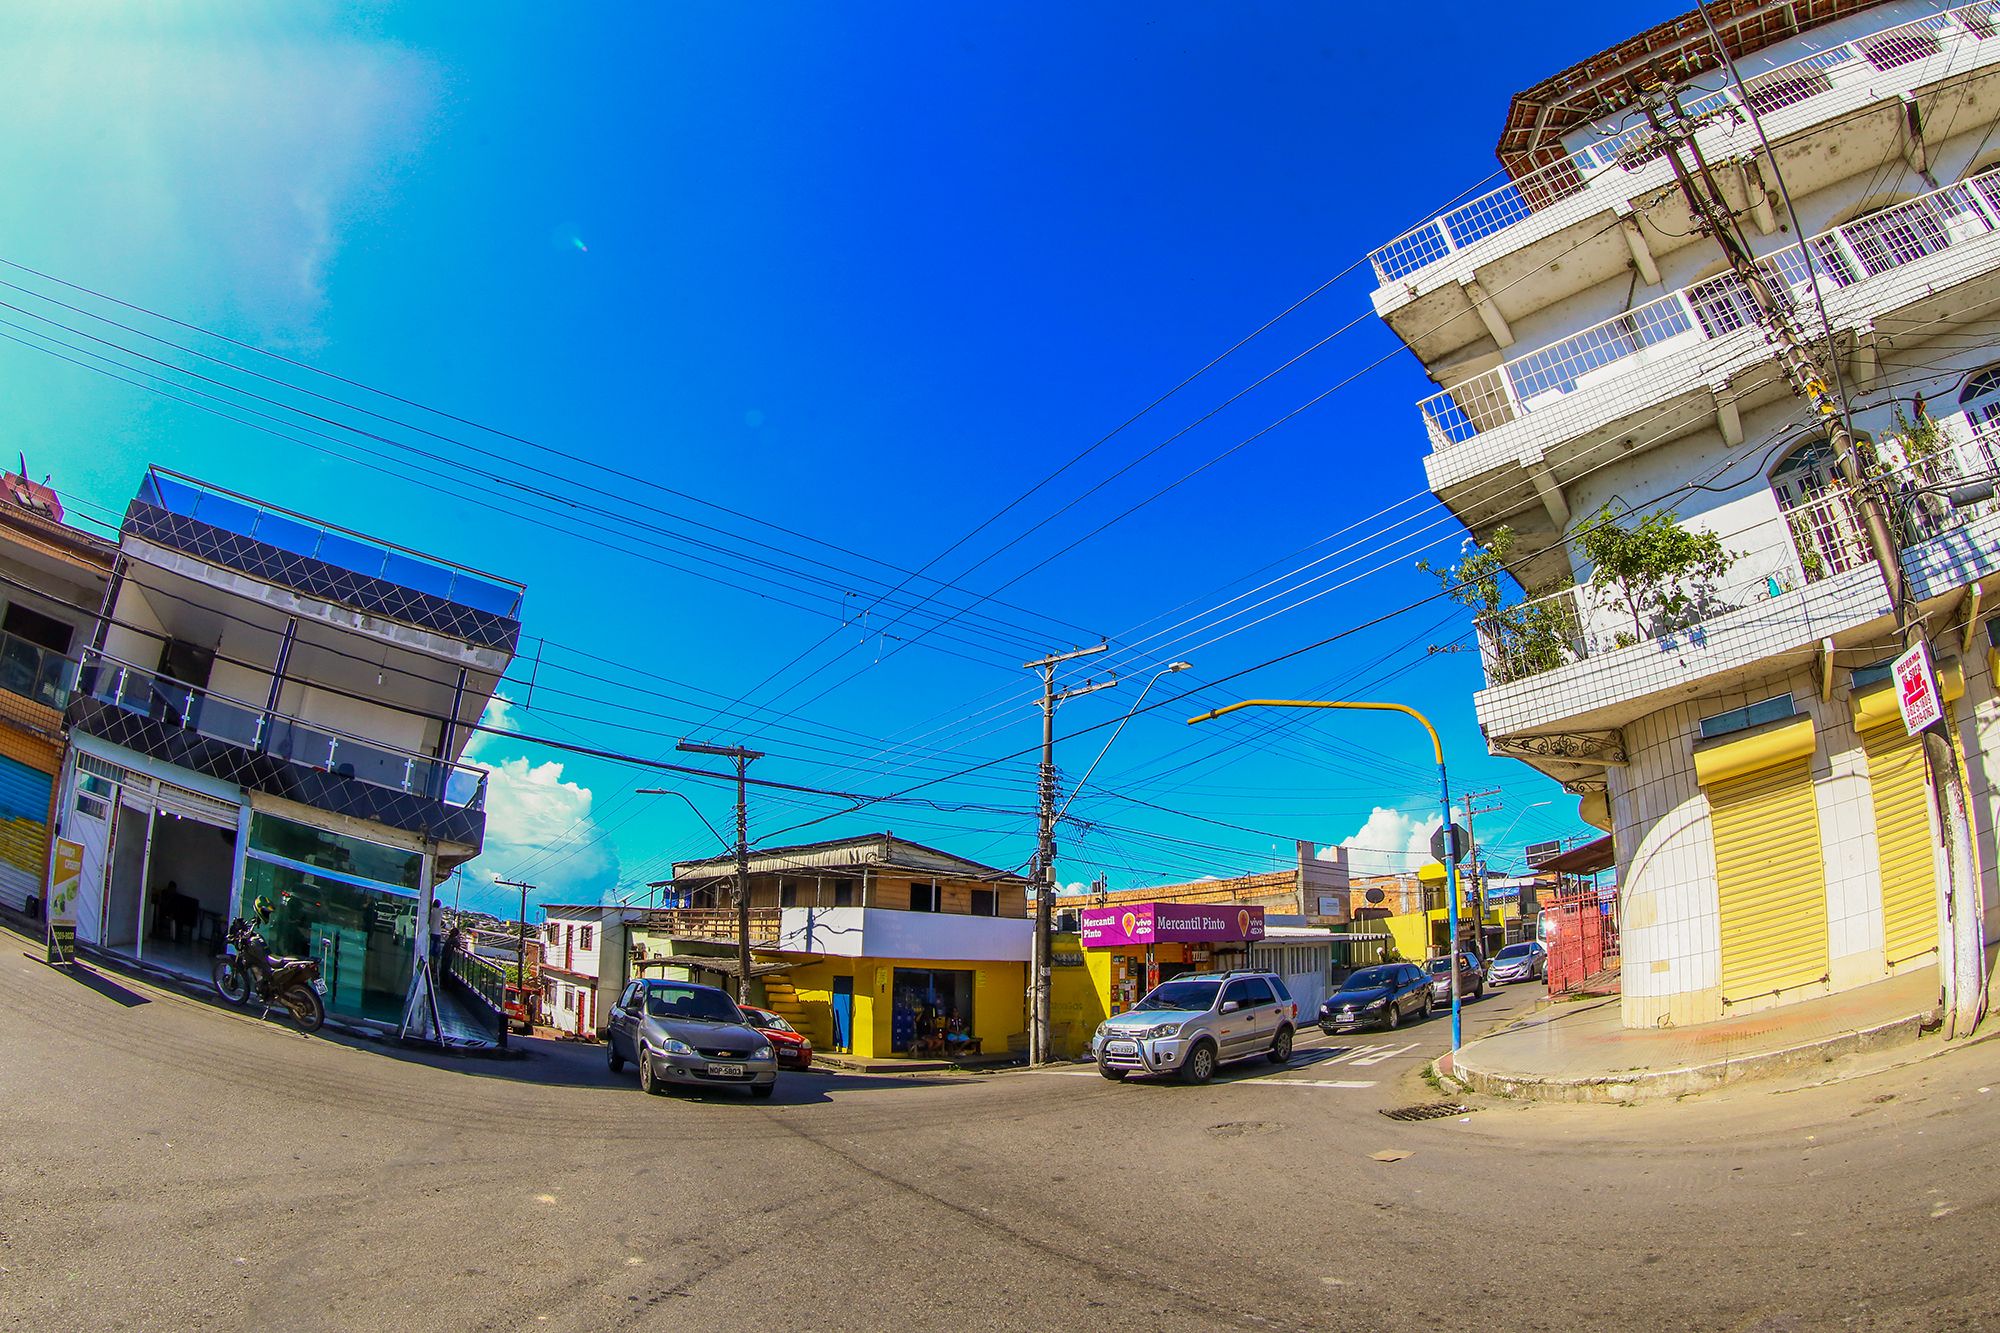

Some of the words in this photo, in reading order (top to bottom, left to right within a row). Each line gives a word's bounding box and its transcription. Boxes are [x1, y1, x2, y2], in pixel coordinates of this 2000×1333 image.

[1897, 651, 1920, 675] REFORMA
[1083, 915, 1115, 927] Mercantil
[1136, 918, 1152, 927] vivo
[1157, 915, 1202, 930] Mercantil
[1202, 917, 1226, 930] Pinto
[1250, 917, 1263, 926] vivo
[1083, 929, 1102, 939] Pinto
